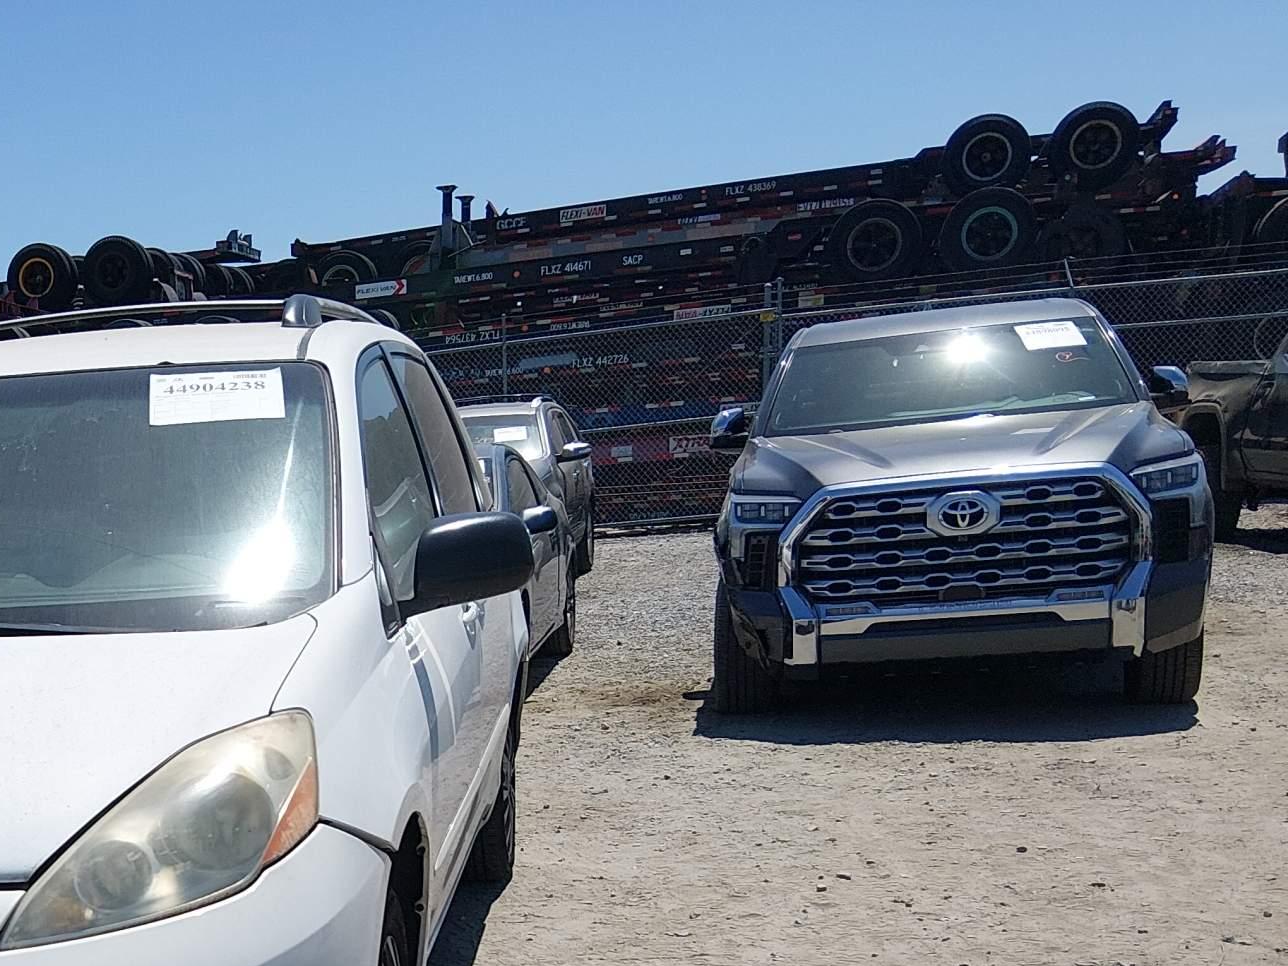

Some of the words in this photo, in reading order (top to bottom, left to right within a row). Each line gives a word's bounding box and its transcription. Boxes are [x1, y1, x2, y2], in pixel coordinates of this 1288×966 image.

[562, 206, 606, 221] FLEXI-VAN
[622, 254, 643, 266] SACP
[540, 263, 562, 276] FLXZ
[564, 260, 591, 272] 414671
[595, 354, 629, 366] 442726
[162, 380, 265, 394] 44904238
